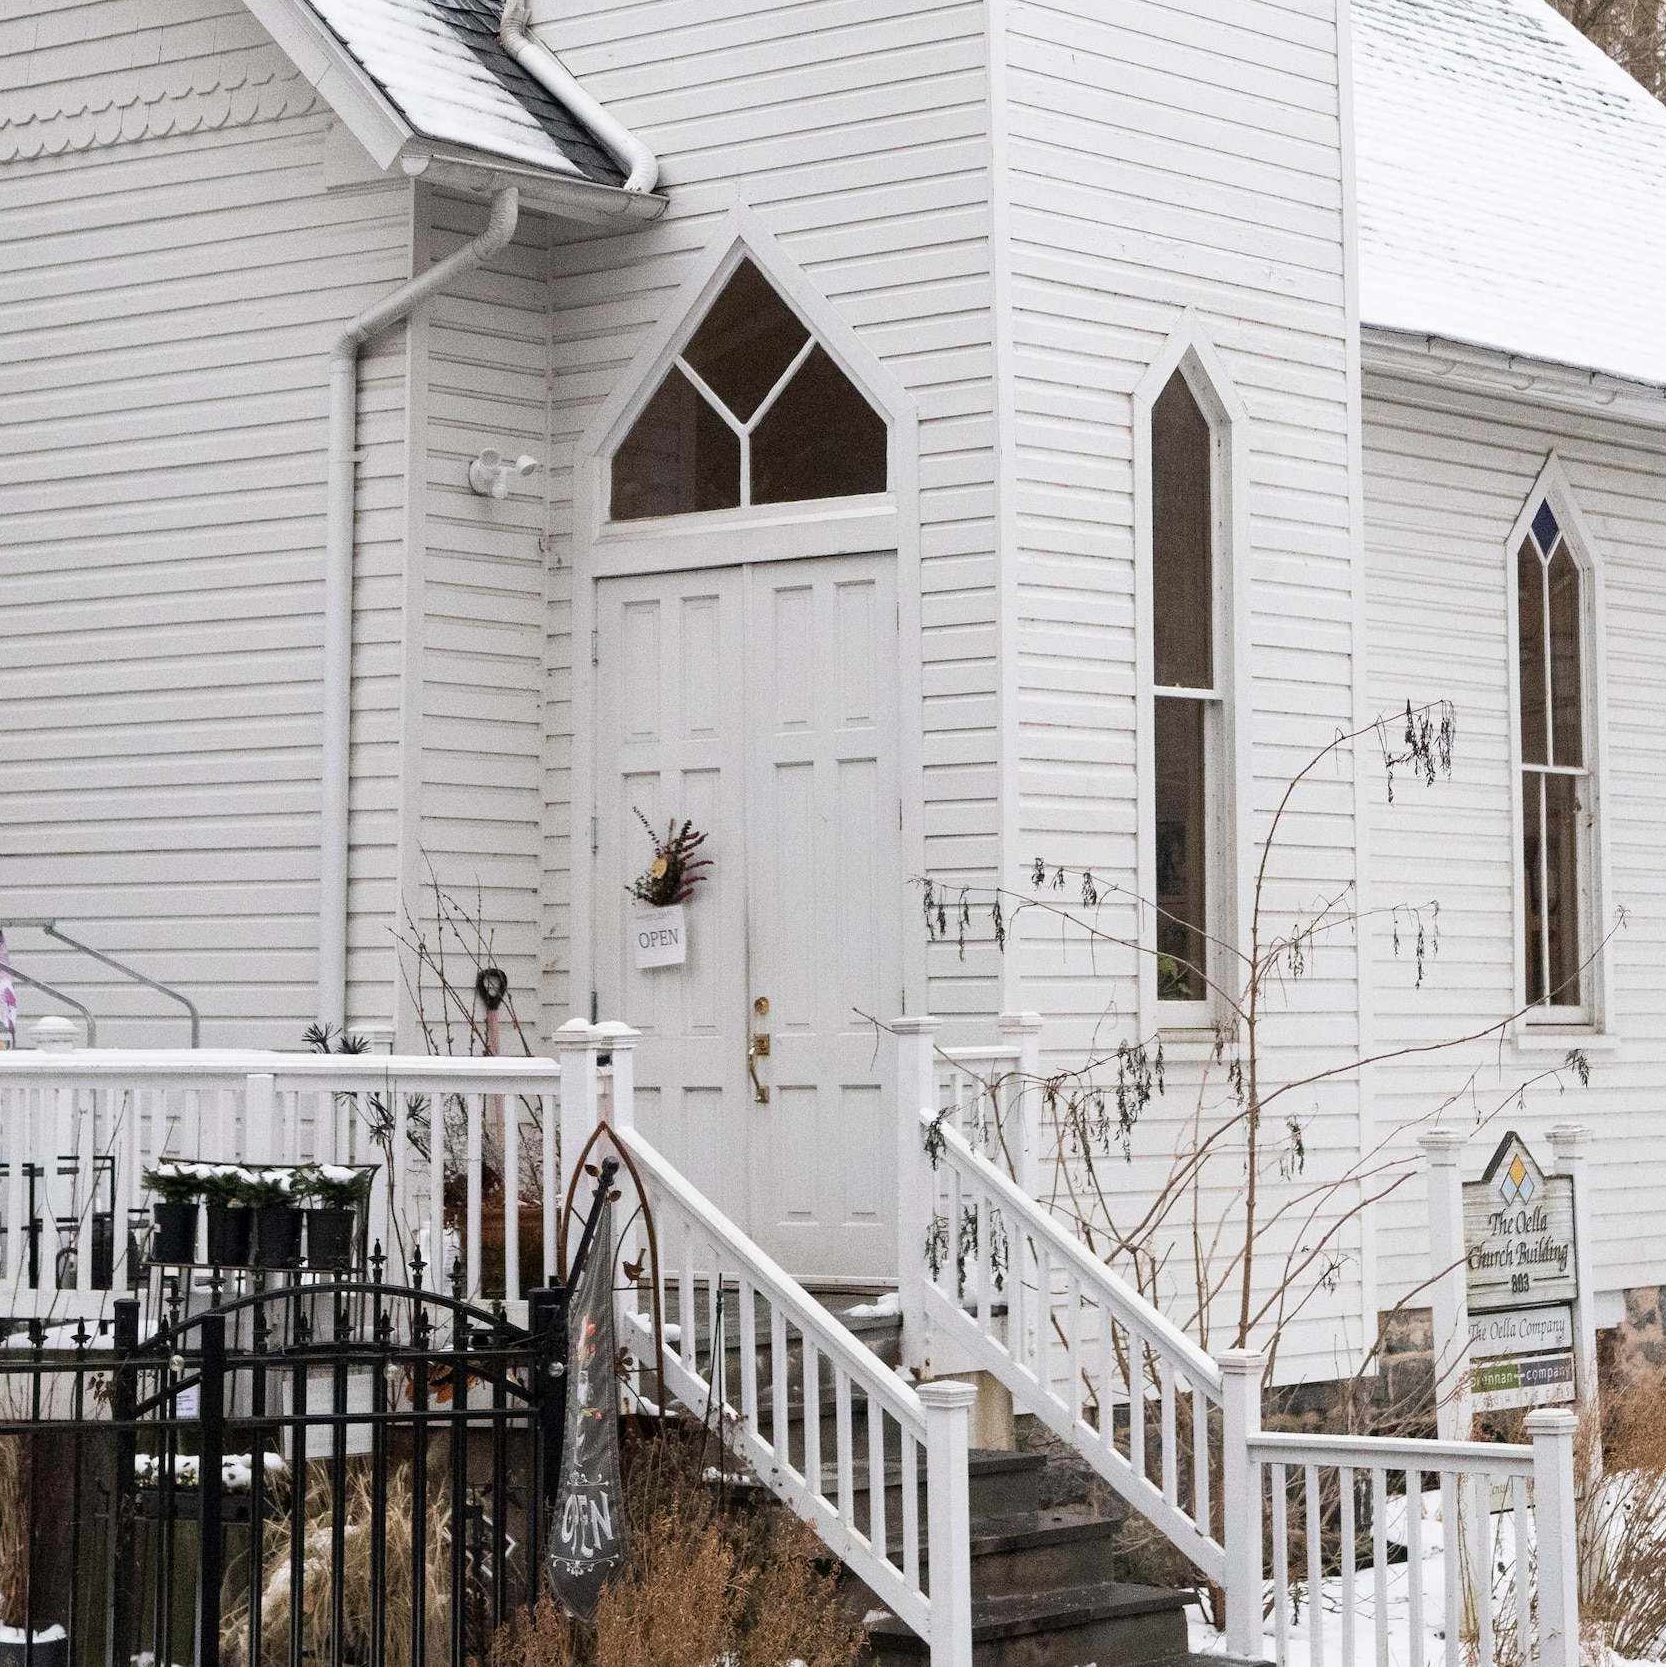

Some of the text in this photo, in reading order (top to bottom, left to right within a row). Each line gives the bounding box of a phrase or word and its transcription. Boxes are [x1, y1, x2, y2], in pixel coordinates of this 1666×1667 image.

[638, 928, 678, 949] OPEN
[1488, 1205, 1547, 1236] The Oella
[1468, 1235, 1569, 1272] Church Building
[1511, 1272, 1530, 1293] 803
[1468, 1317, 1566, 1342] The Oella Company
[1472, 1386, 1571, 1408] ACHITECS
